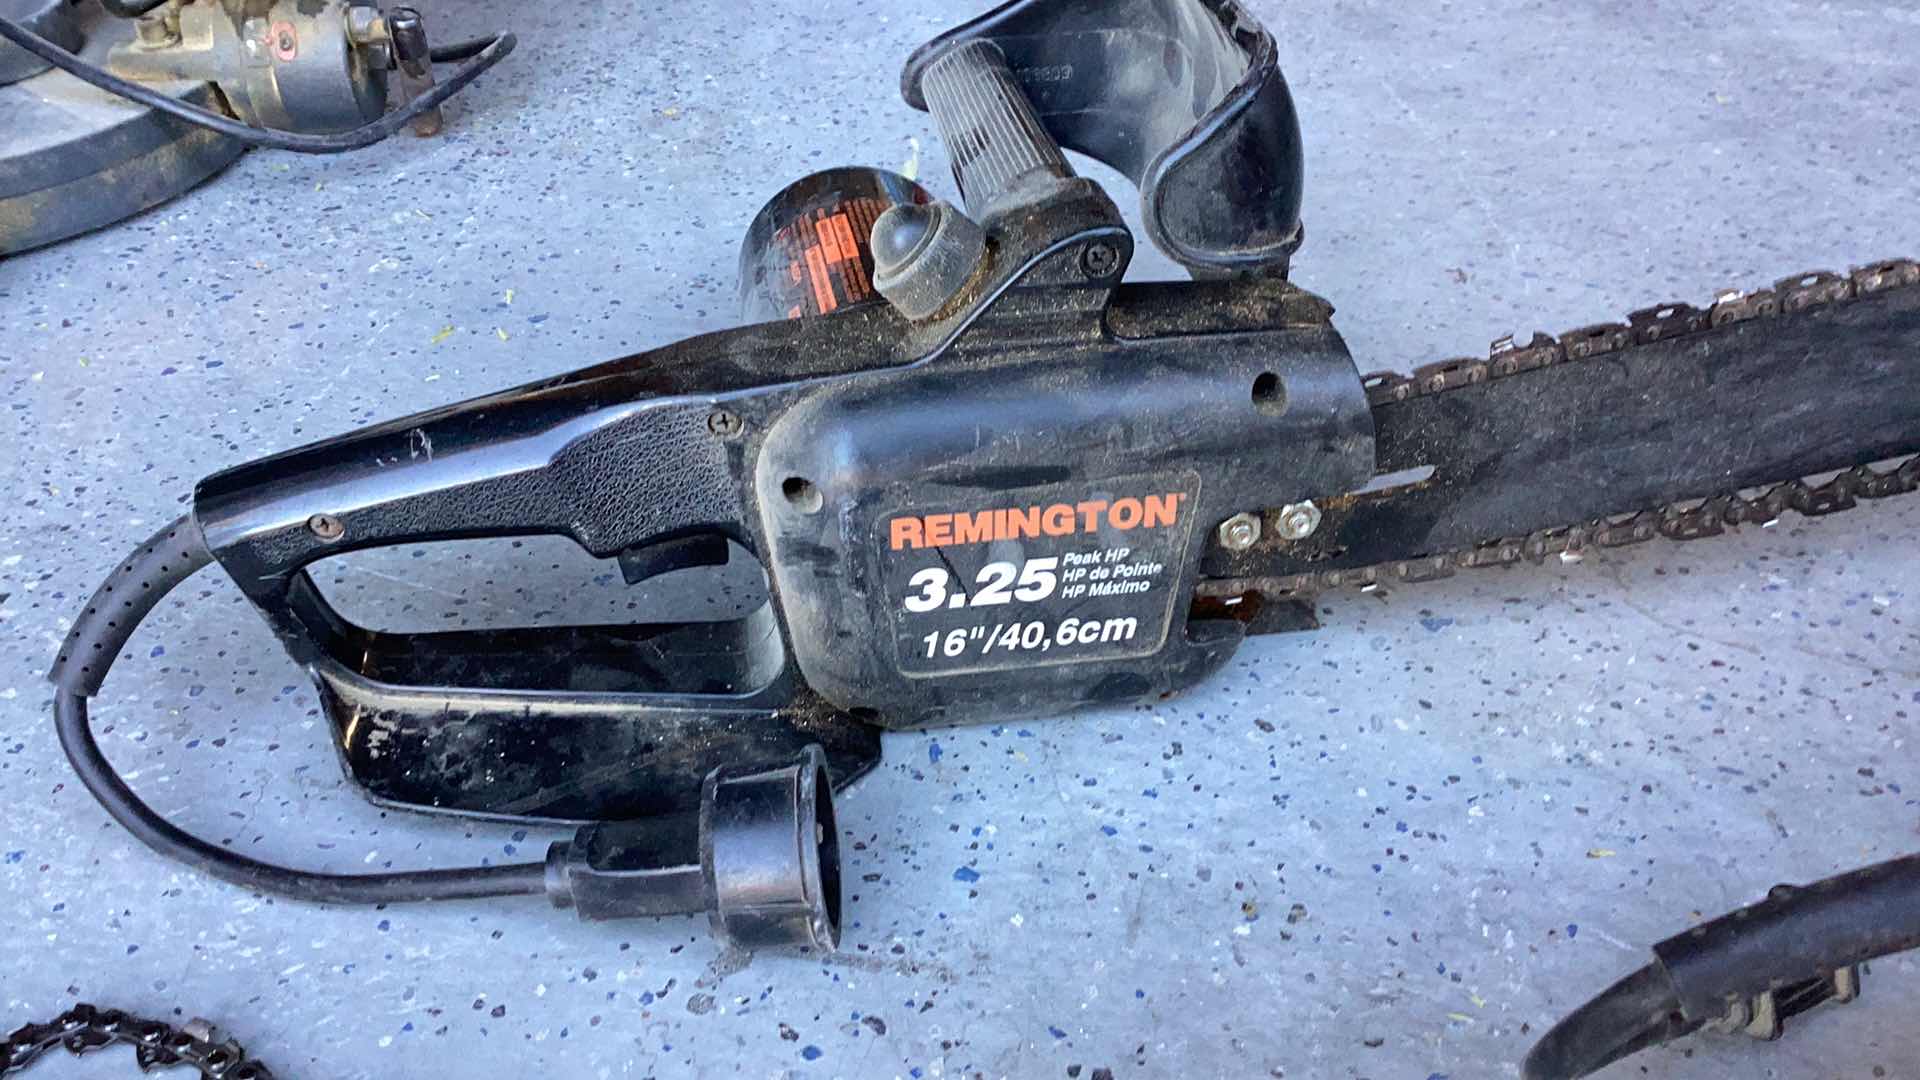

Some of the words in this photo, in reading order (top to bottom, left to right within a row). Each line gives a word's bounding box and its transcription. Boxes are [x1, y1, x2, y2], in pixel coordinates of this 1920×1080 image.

[890, 493, 1180, 550] REMINGTON
[1062, 549, 1102, 567] Peak
[1104, 547, 1131, 564] HP
[1062, 567, 1087, 583] HP
[1088, 565, 1110, 580] de
[1112, 561, 1163, 579] Pointe
[904, 556, 1059, 613] 3.25
[1061, 583, 1086, 599] HP
[1088, 579, 1151, 597] Máximo
[922, 616, 1138, 658] 16"/40,6cm
